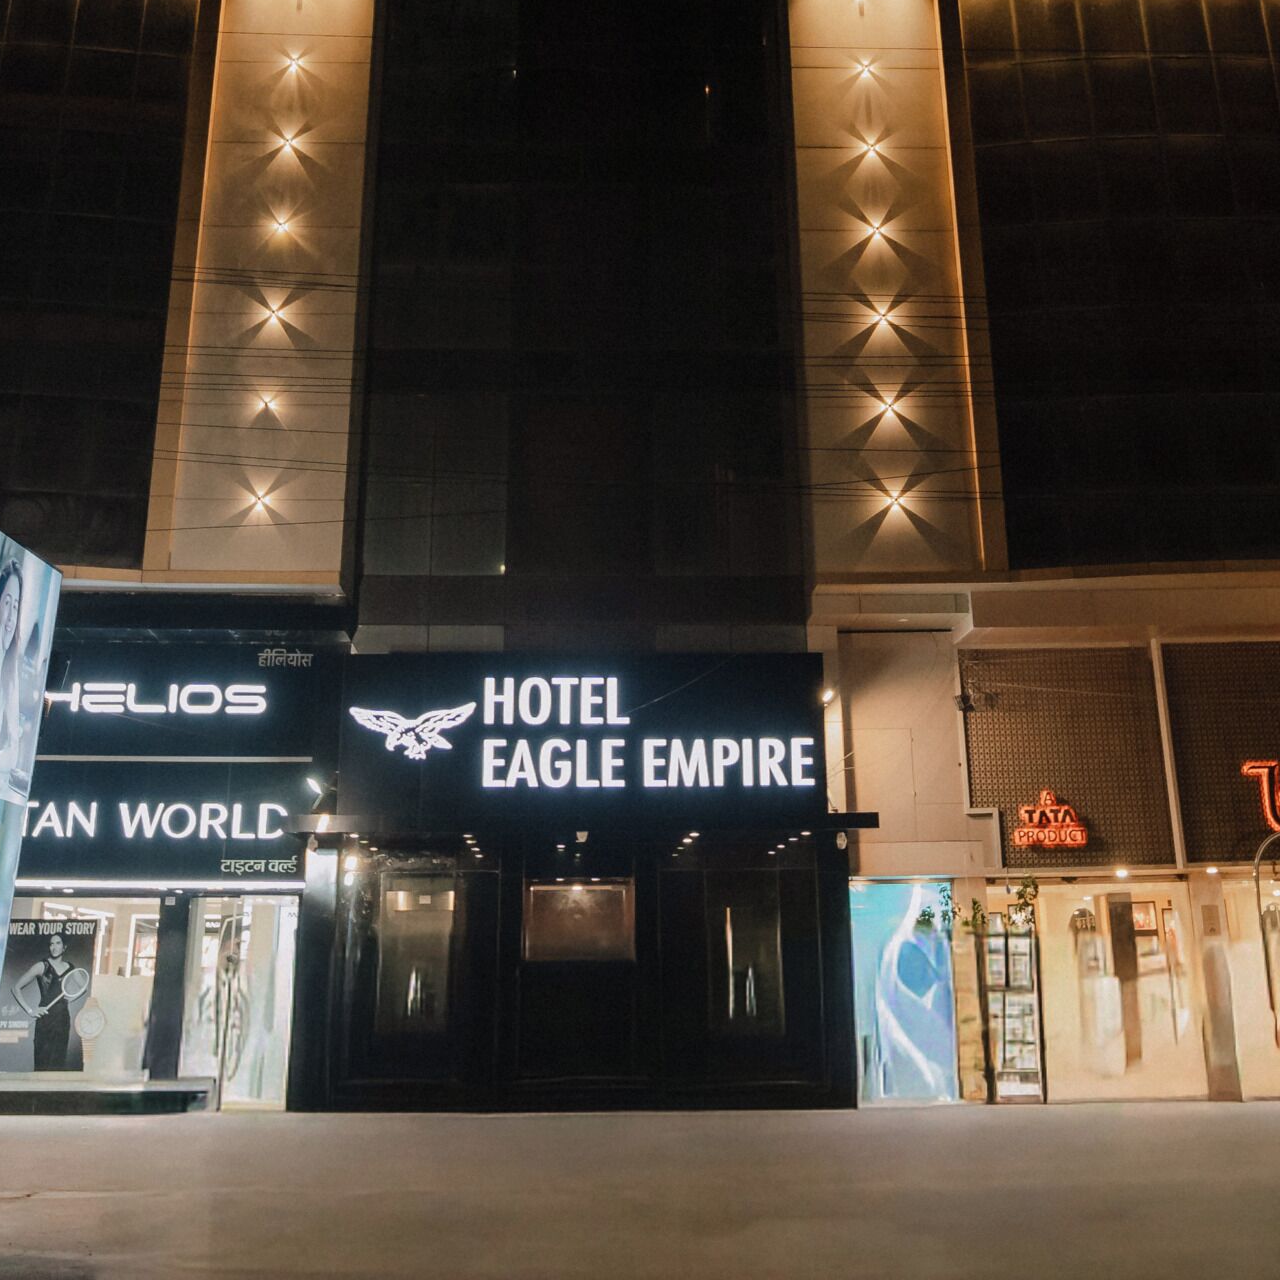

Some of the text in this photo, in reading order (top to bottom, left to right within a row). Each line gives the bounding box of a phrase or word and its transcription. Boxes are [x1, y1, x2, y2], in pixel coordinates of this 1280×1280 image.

[257, 648, 314, 667] हीलियोस
[44, 681, 268, 715] HELIOS
[483, 676, 631, 725] HOTEL
[481, 737, 816, 788] EAGLE EMPIRE
[119, 801, 289, 840] WORLD
[1022, 807, 1077, 826] TATA
[1016, 828, 1086, 844] PRODUCT
[221, 855, 298, 876] टाइटन वर्ल्ड
[10, 922, 96, 936] WEAR YOUR STORY
